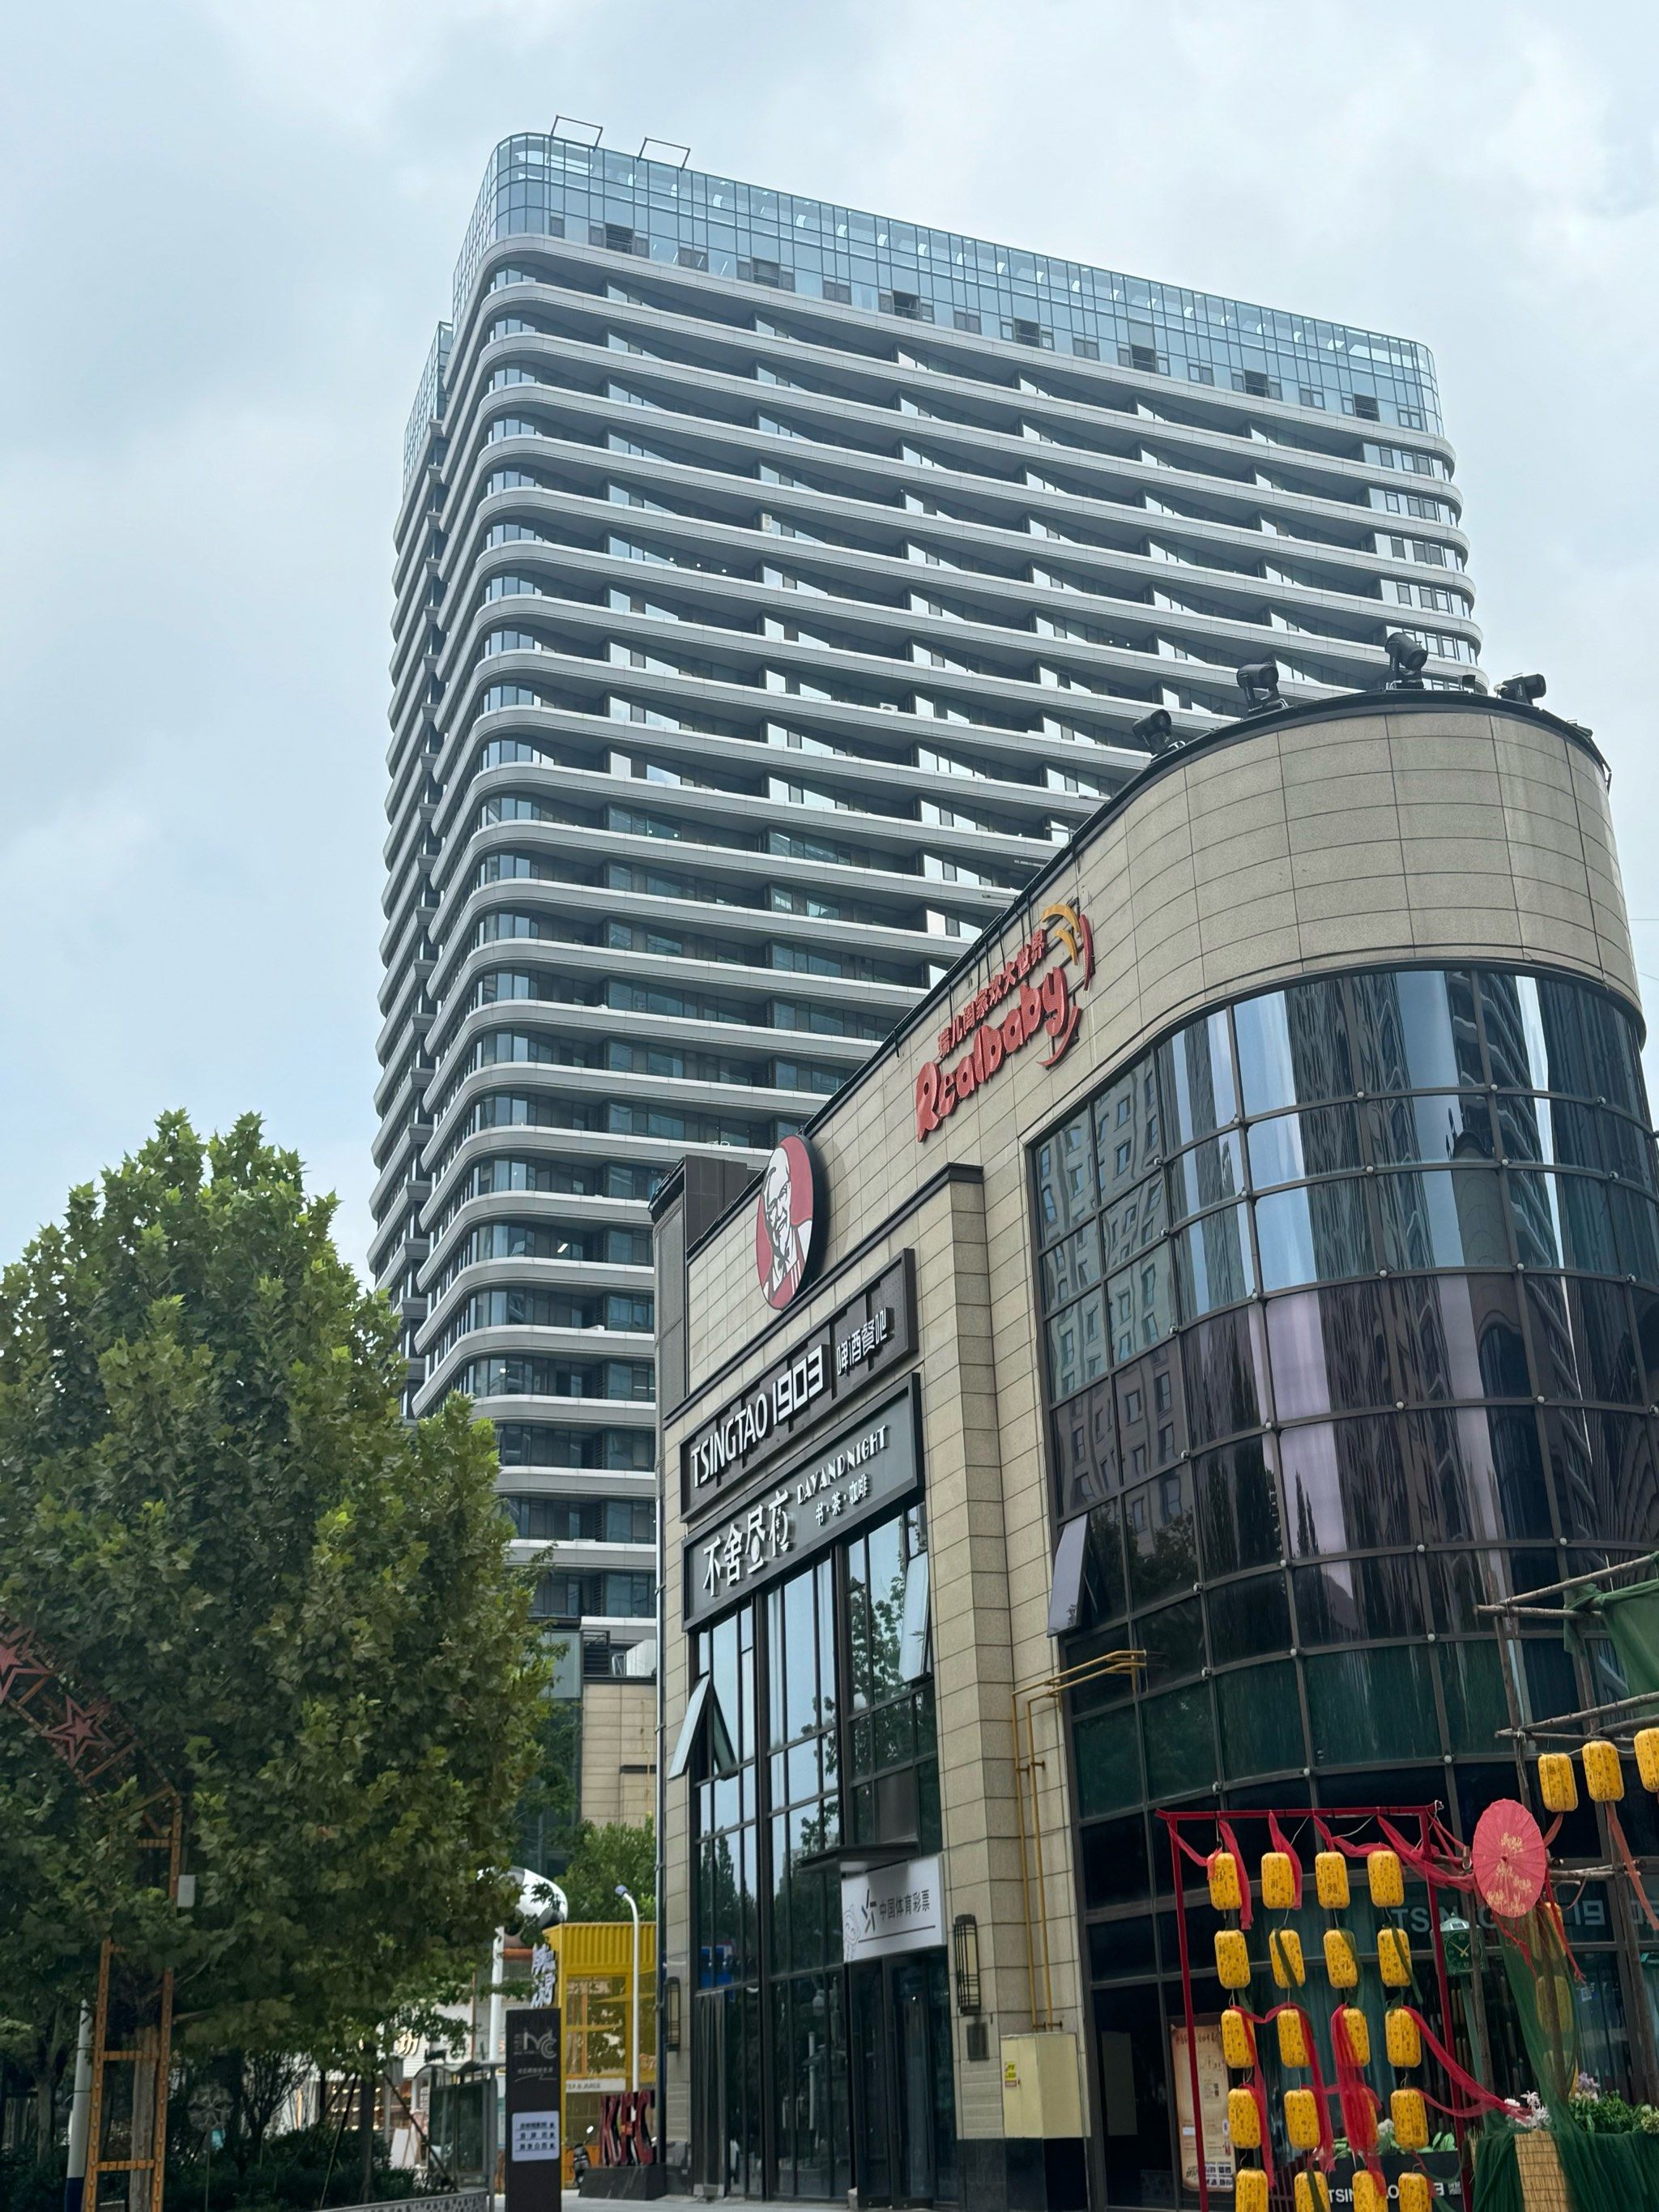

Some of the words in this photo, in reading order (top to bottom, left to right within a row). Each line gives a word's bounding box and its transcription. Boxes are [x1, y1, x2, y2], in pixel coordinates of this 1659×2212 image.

[915, 966, 1081, 1143] Realbaby
[690, 1393, 768, 1488] TSINGTAO
[772, 1344, 824, 1426] 1903
[836, 1308, 888, 1377] 啤酒餐吧
[879, 1890, 930, 1922] 中国体育彩票
[599, 2089, 658, 2167] KFC
